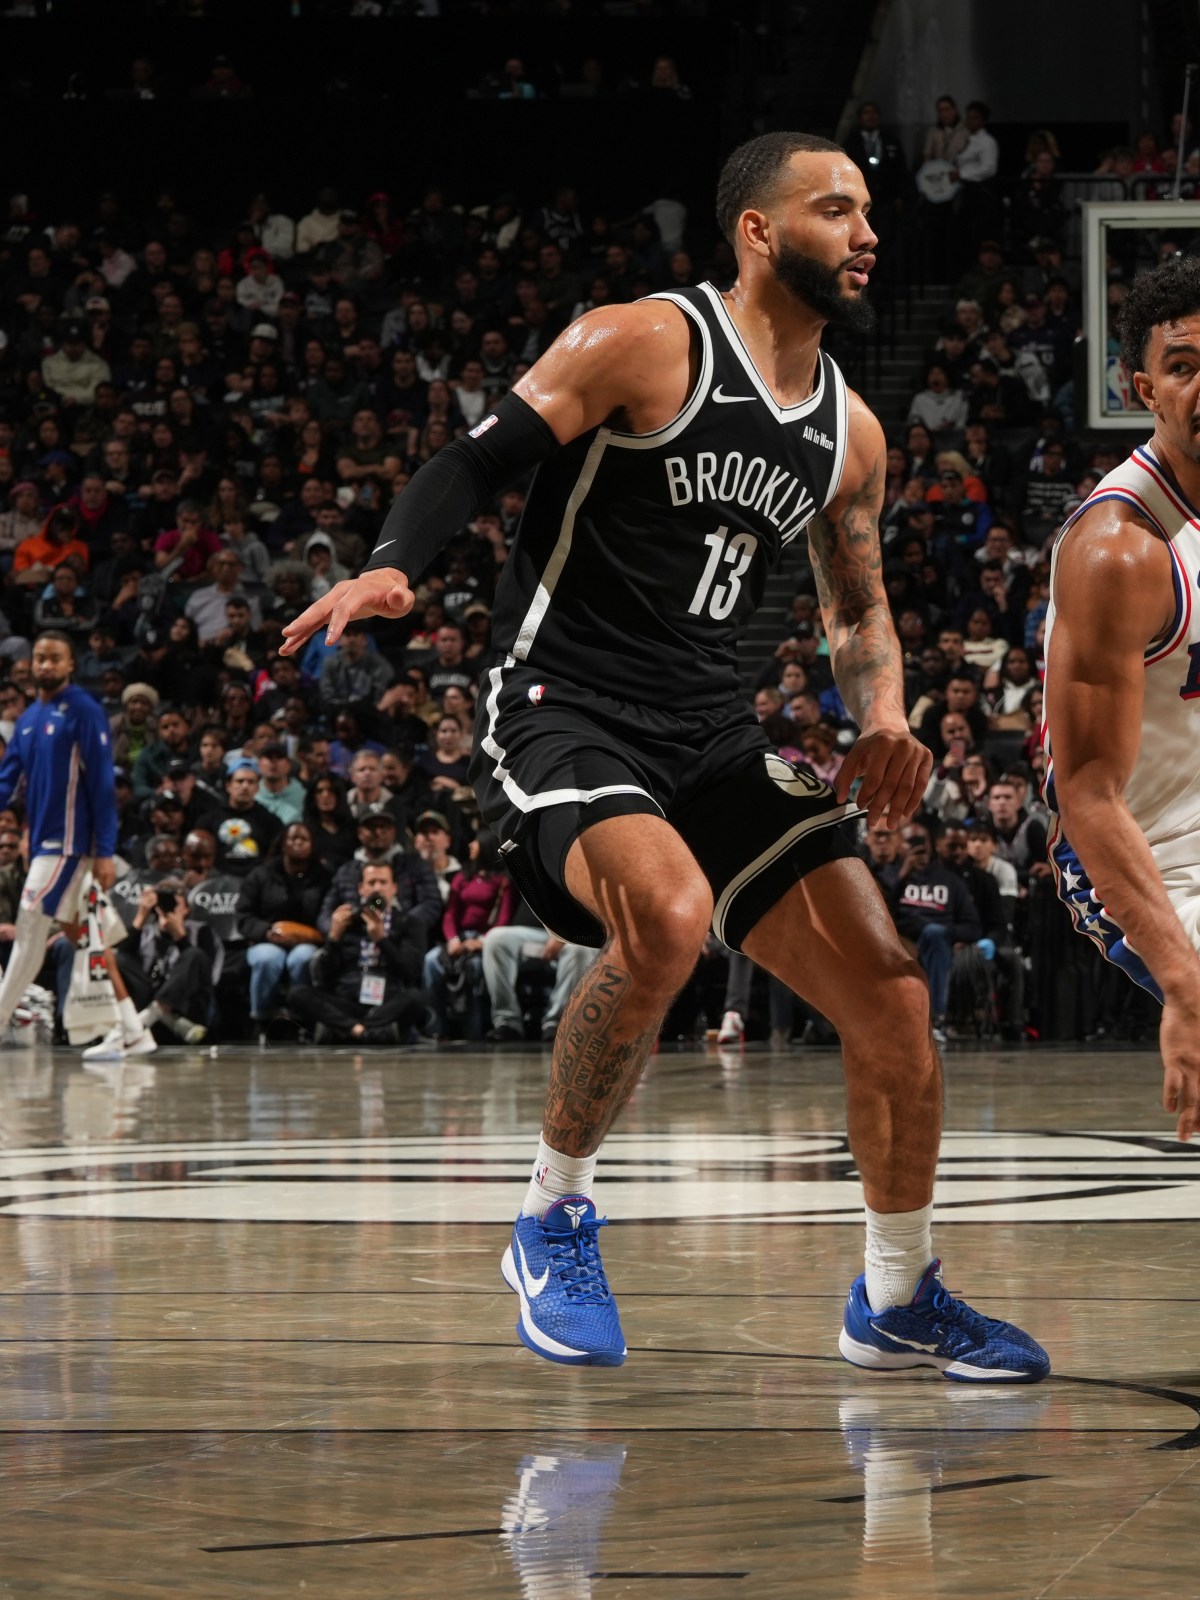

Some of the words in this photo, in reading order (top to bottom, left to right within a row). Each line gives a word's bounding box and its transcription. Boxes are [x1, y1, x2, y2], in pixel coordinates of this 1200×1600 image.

[802, 425, 813, 441] All
[812, 429, 820, 444] In
[819, 432, 834, 451] Won
[687, 525, 758, 620] 13
